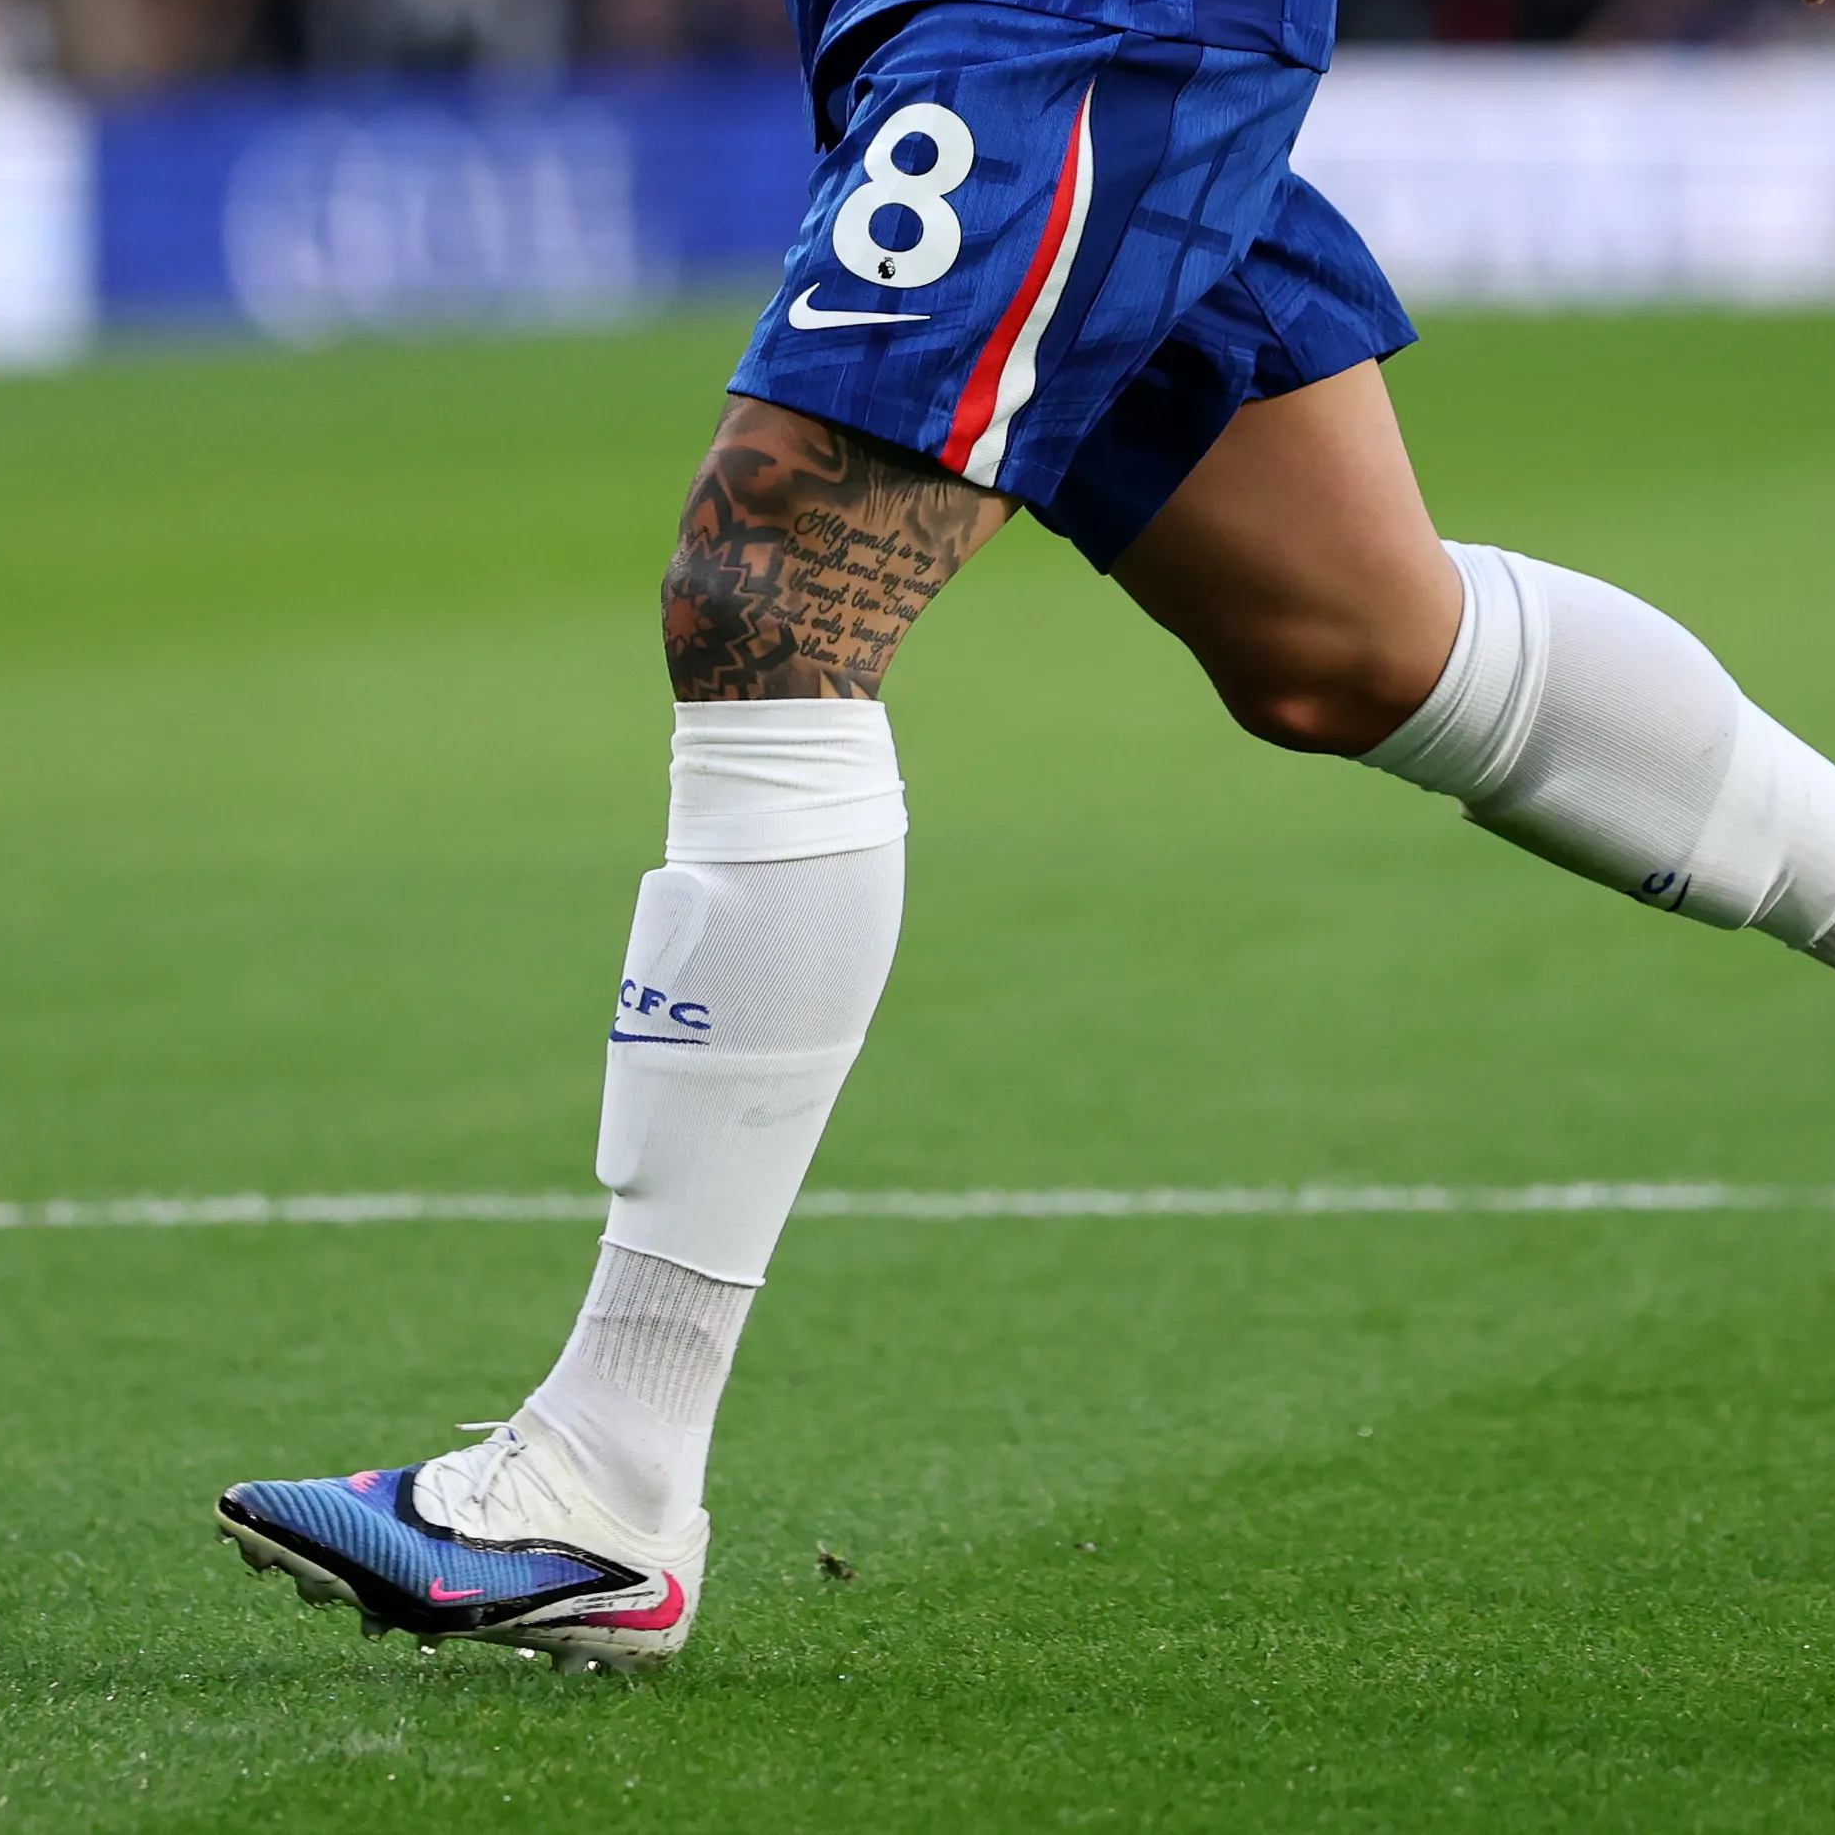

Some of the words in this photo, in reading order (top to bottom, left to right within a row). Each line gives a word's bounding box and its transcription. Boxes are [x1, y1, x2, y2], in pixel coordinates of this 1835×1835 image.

[832, 101, 975, 290] 8
[794, 508, 847, 550] My
[841, 527, 900, 563] family
[914, 550, 936, 575] my
[847, 563, 887, 581] and
[811, 612, 845, 644] only
[620, 979, 711, 1030] CFC
